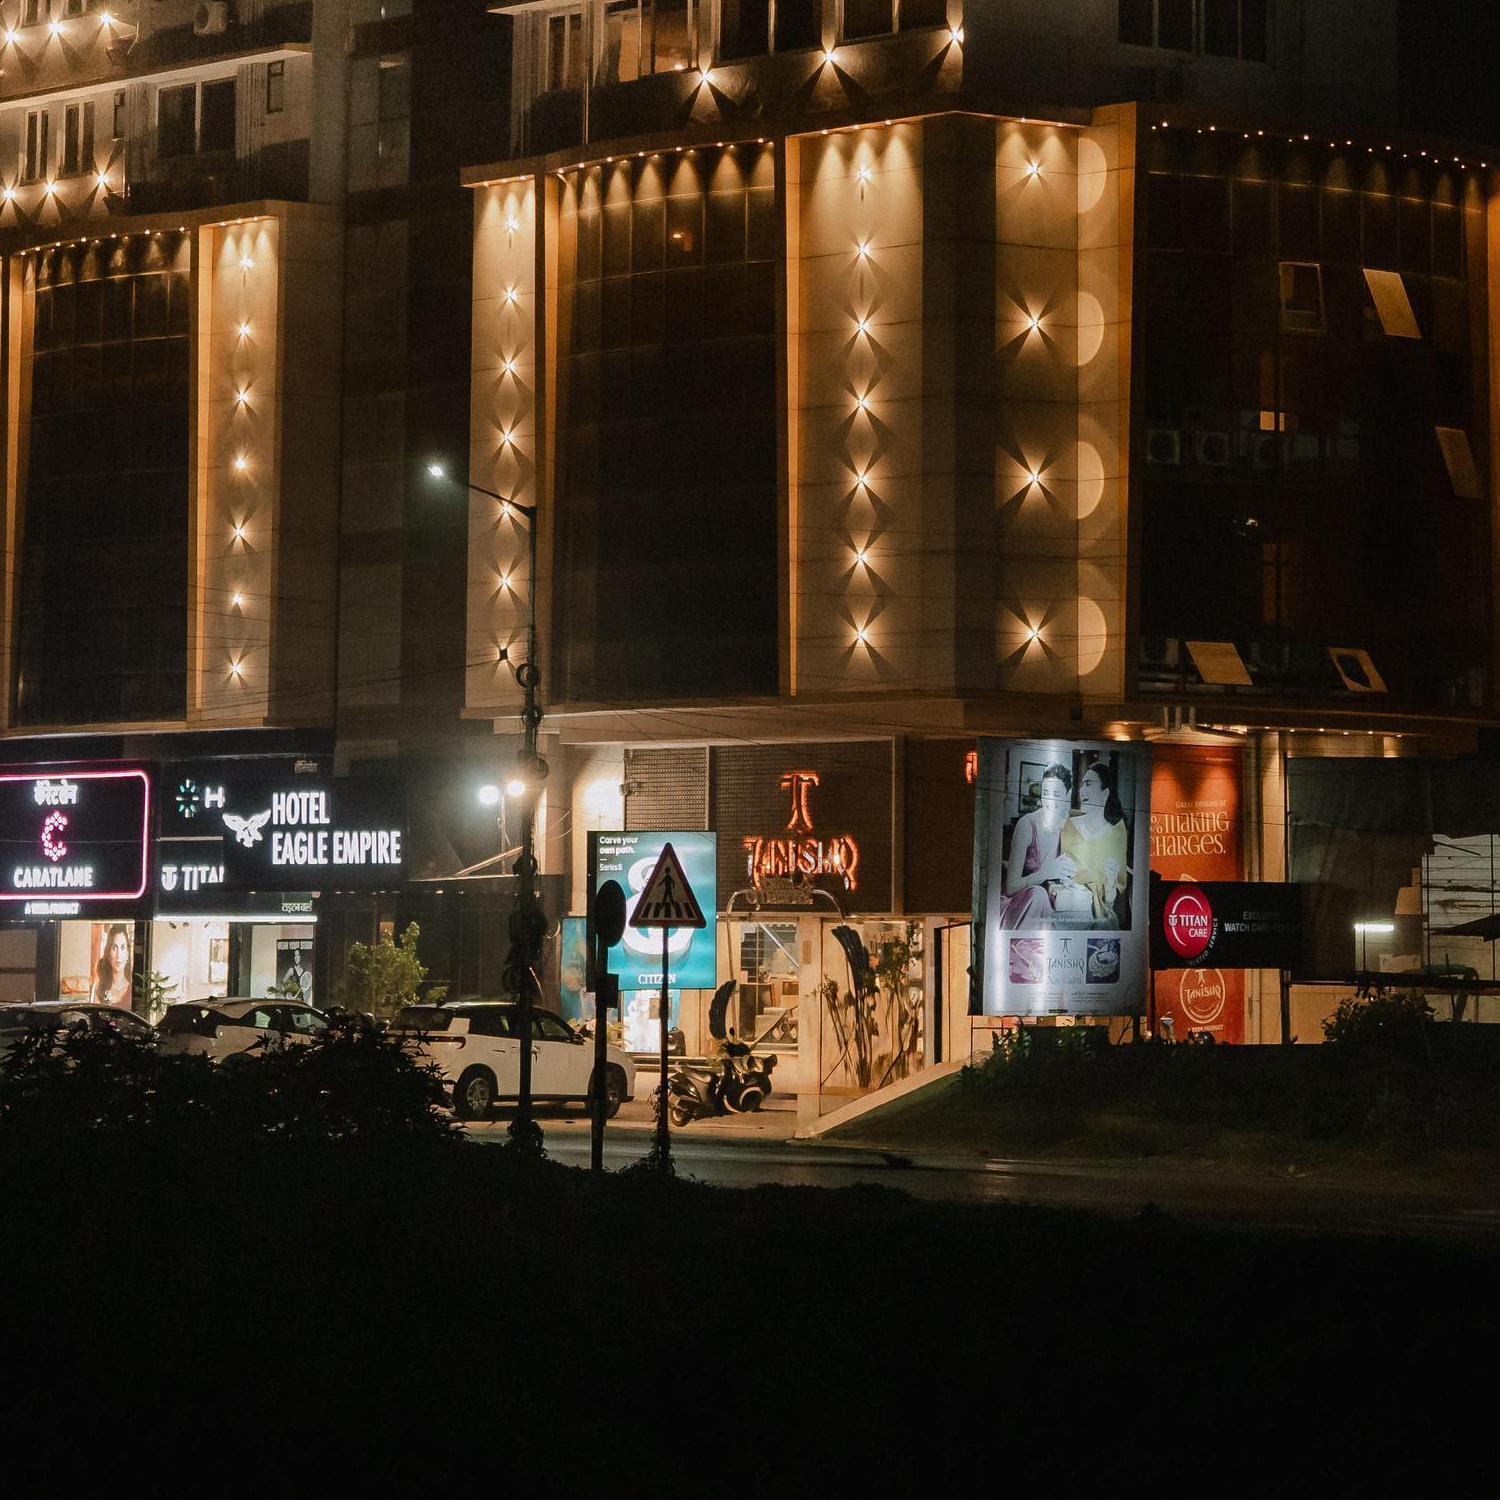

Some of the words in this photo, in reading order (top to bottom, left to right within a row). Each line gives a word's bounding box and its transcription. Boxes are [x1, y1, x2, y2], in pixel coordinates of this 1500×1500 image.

[204, 786, 225, 809] H
[272, 790, 330, 825] HOTEL
[272, 830, 328, 865] EAGLE
[333, 830, 402, 865] EMPIRE
[599, 836, 622, 844] Carve
[622, 836, 639, 846] your
[742, 835, 859, 892] TANISHQ
[13, 867, 94, 888] CARATLANE
[181, 866, 225, 891] TITA
[1179, 914, 1208, 927] TITAN
[1224, 921, 1250, 933] WATCH
[1188, 928, 1208, 938] CARE
[1046, 957, 1085, 973] TANISHQ
[638, 974, 677, 984] CITIZN
[1184, 984, 1221, 1005] TANISHQ
